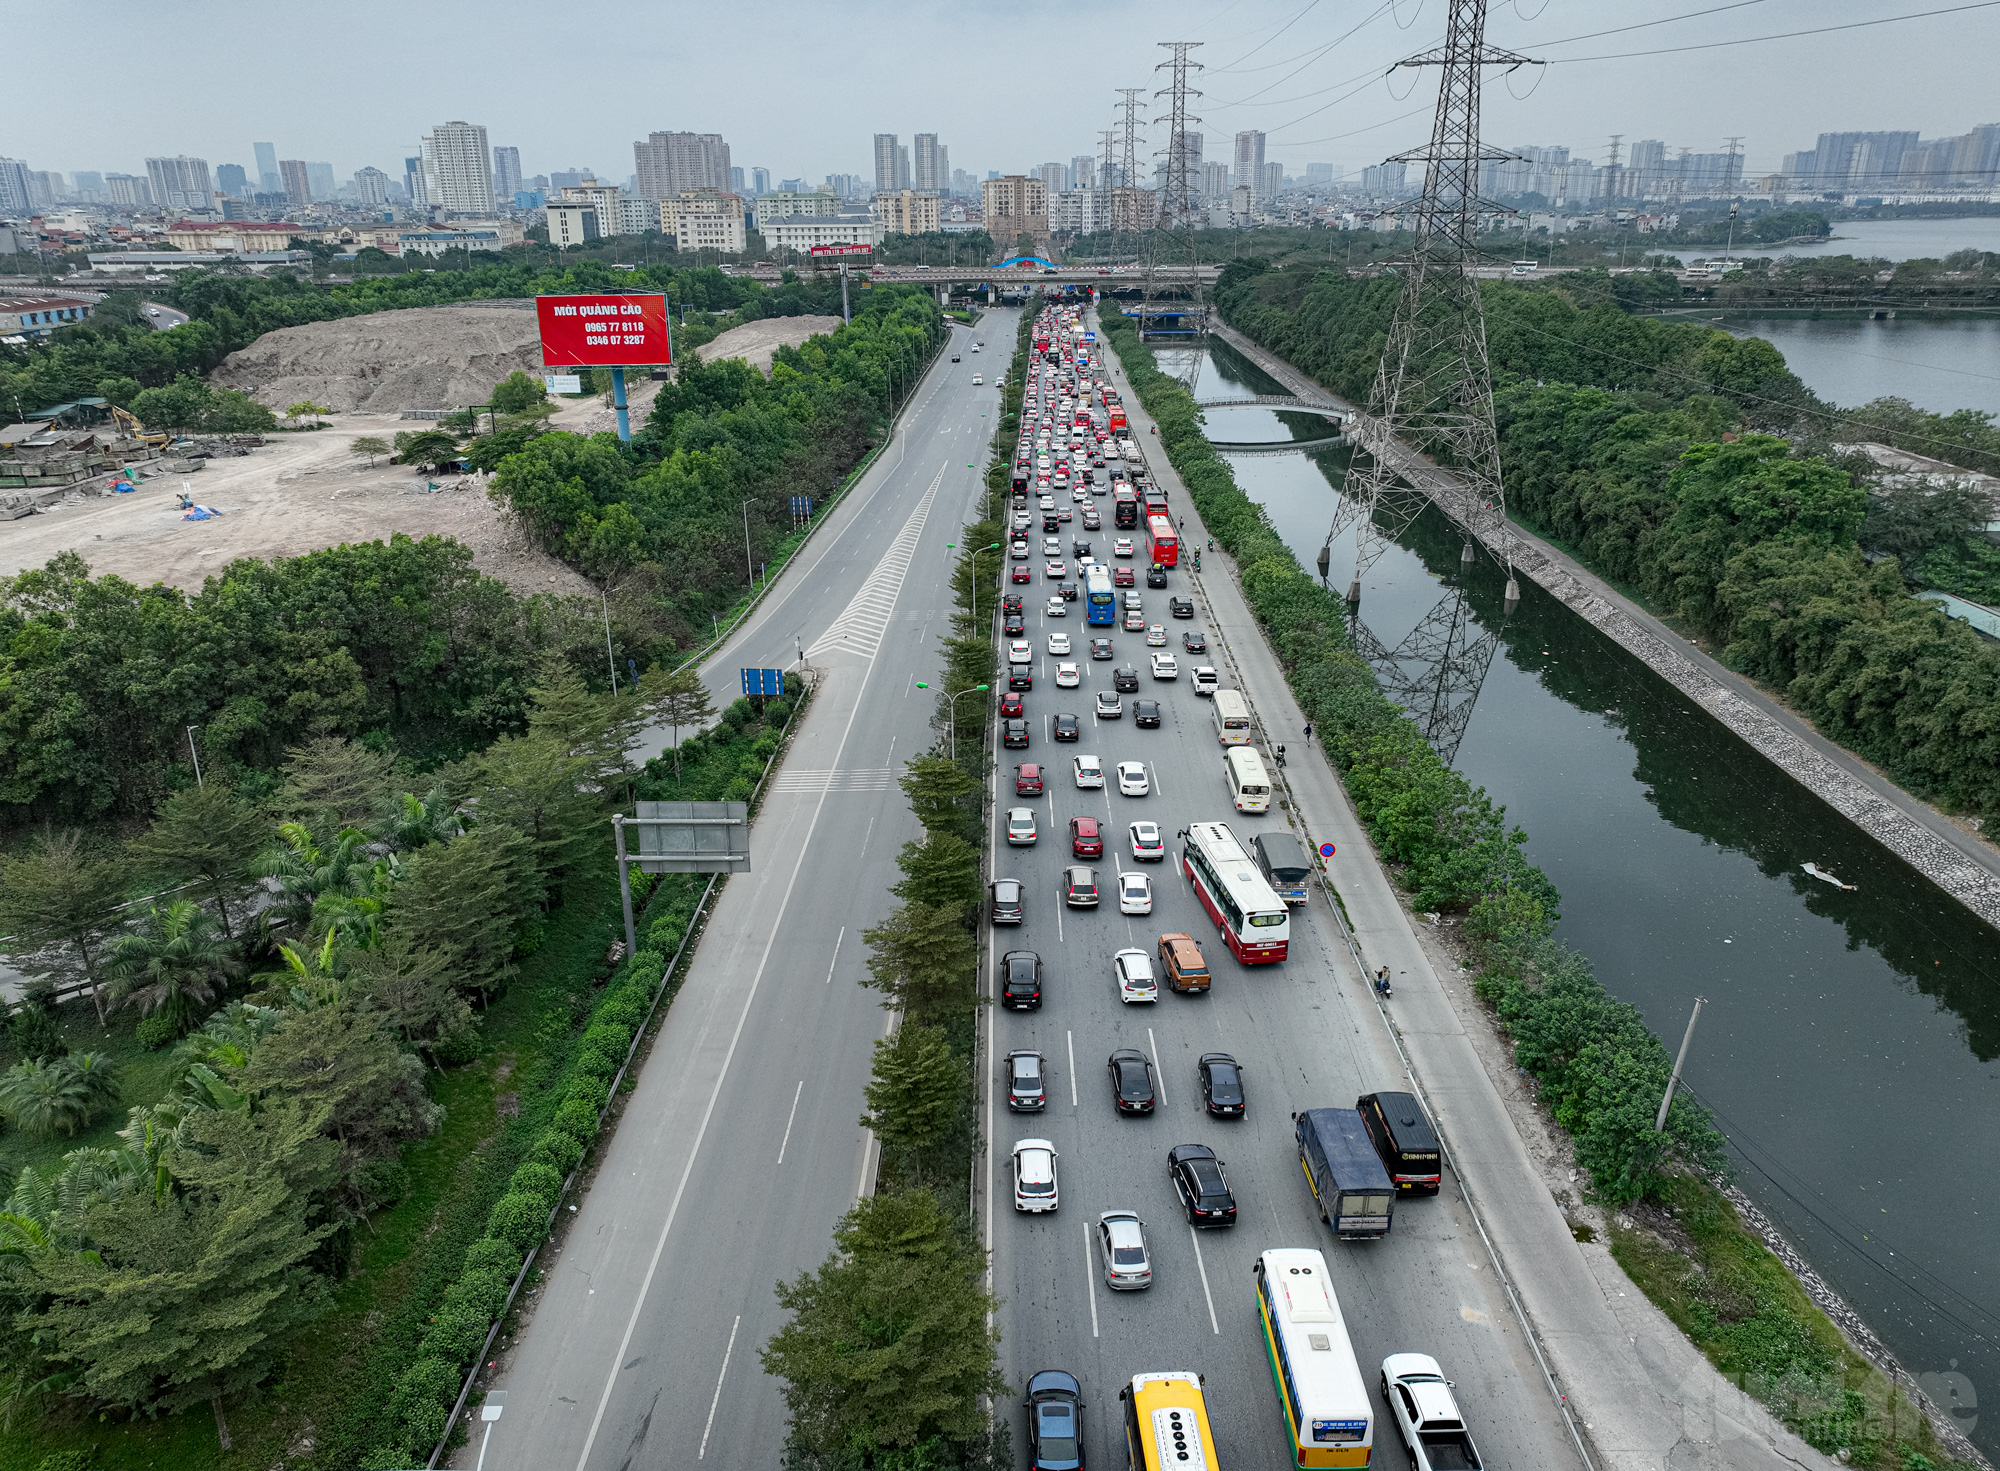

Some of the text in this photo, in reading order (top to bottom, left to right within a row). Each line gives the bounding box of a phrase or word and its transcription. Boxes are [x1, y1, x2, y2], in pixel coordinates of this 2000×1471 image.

[579, 303, 618, 317] QUẢNG
[620, 303, 642, 315] CÁO
[585, 321, 644, 332] 0965 77 8118
[586, 334, 645, 345] 0346 07 3287
